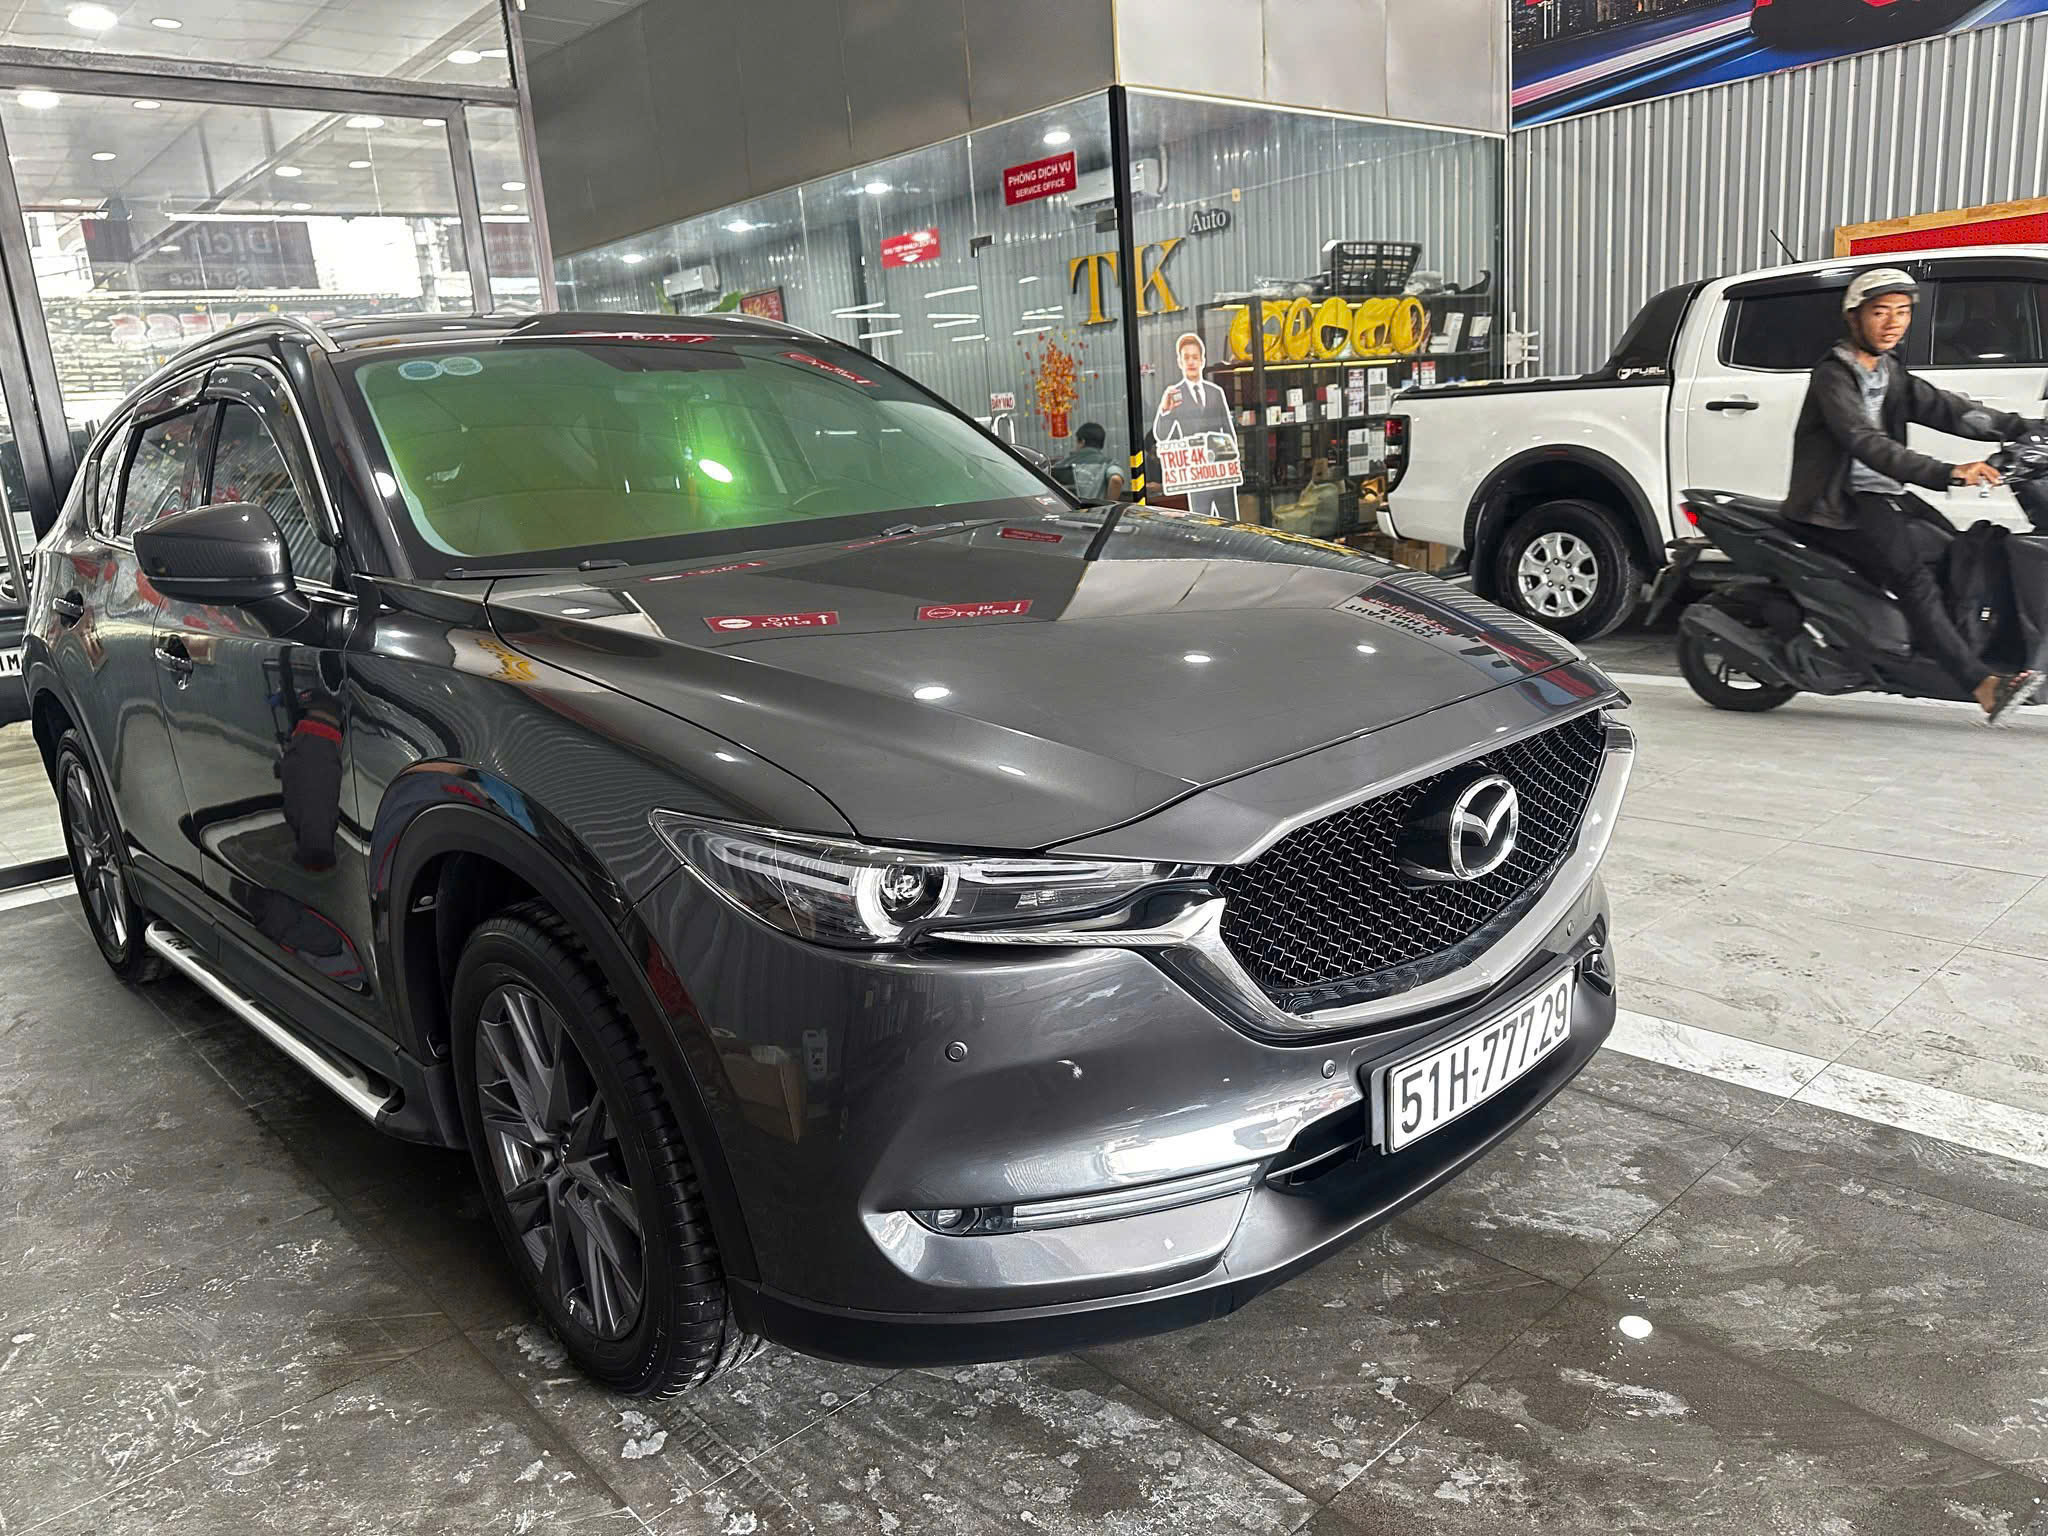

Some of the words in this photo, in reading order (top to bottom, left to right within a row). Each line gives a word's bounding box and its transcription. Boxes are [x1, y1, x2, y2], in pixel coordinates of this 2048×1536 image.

[1008, 171, 1037, 187] PHÒNG
[1037, 163, 1058, 180] DỊCH
[1059, 160, 1072, 174] VỤ
[1015, 184, 1042, 198] SERVICE
[1042, 177, 1066, 191] OFFICE
[1189, 209, 1228, 233] Auto
[1160, 449, 1190, 469] TRUE
[1191, 447, 1207, 465] 4K
[1165, 469, 1177, 484] AS
[1178, 468, 1188, 482] IT
[1190, 463, 1226, 481] SHOULD
[1227, 461, 1241, 476] BE
[1401, 982, 1569, 1134] 51H-777.29
